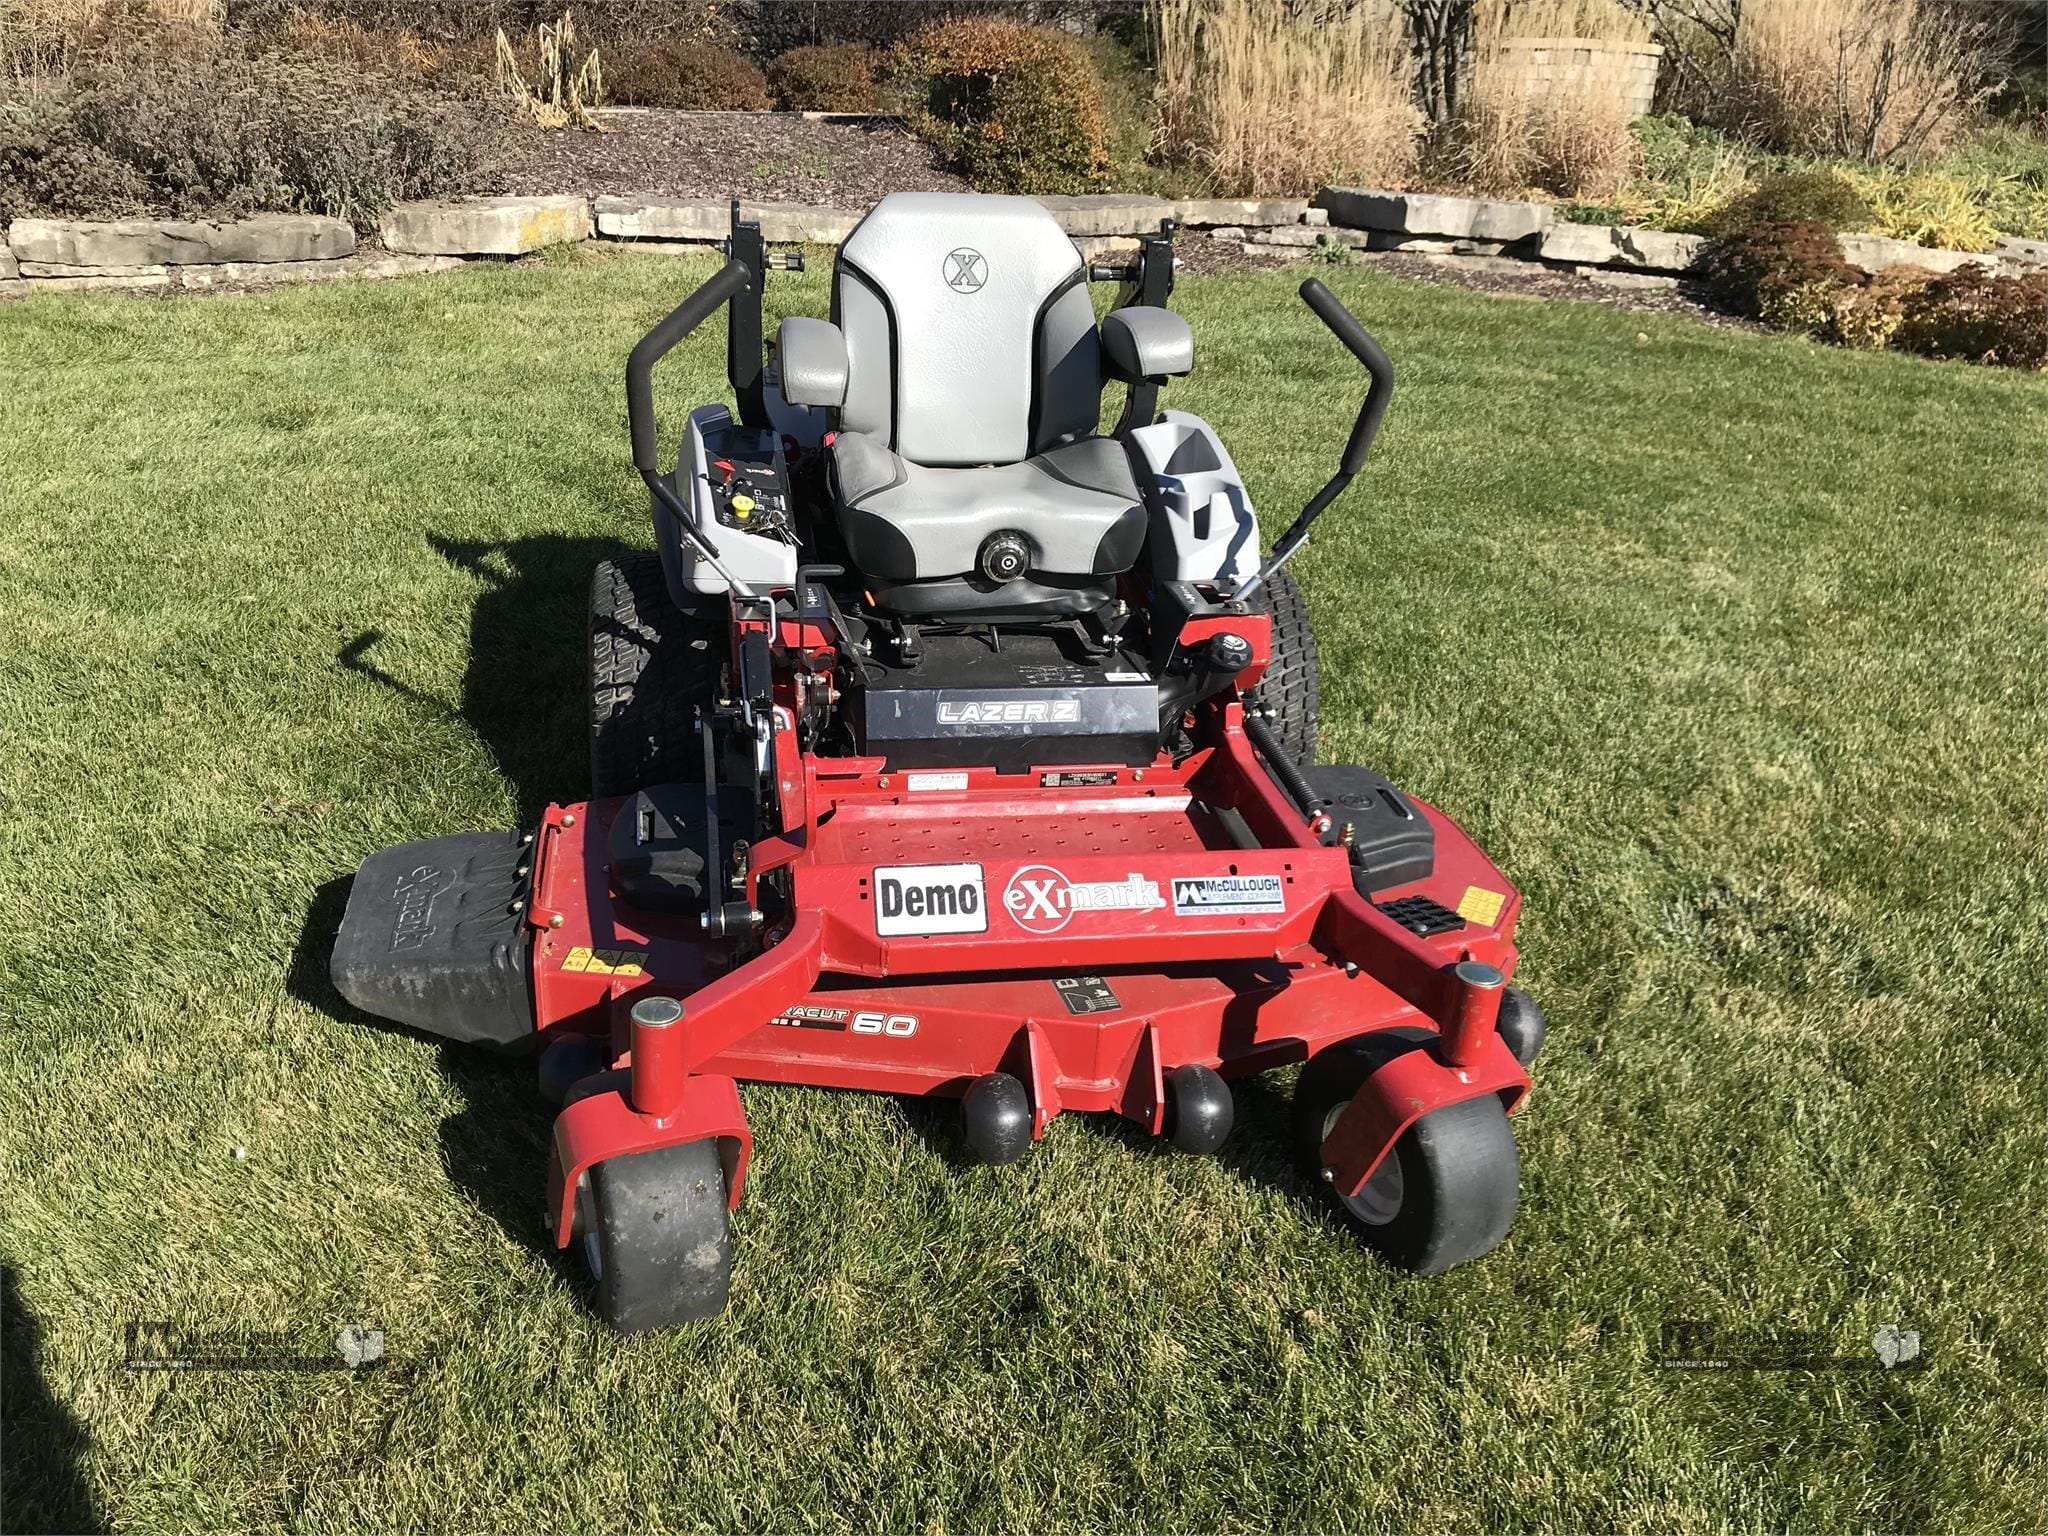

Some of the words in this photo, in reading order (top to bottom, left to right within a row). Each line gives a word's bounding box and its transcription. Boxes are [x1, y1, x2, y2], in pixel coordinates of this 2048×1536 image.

[950, 253, 982, 287] X
[938, 702, 1047, 723] LAZER
[1052, 701, 1078, 722] Z
[880, 878, 979, 918] Demo
[1004, 876, 1160, 920] eXmark
[1206, 879, 1280, 892] McCULLOUGH
[851, 1011, 919, 1037] 60
